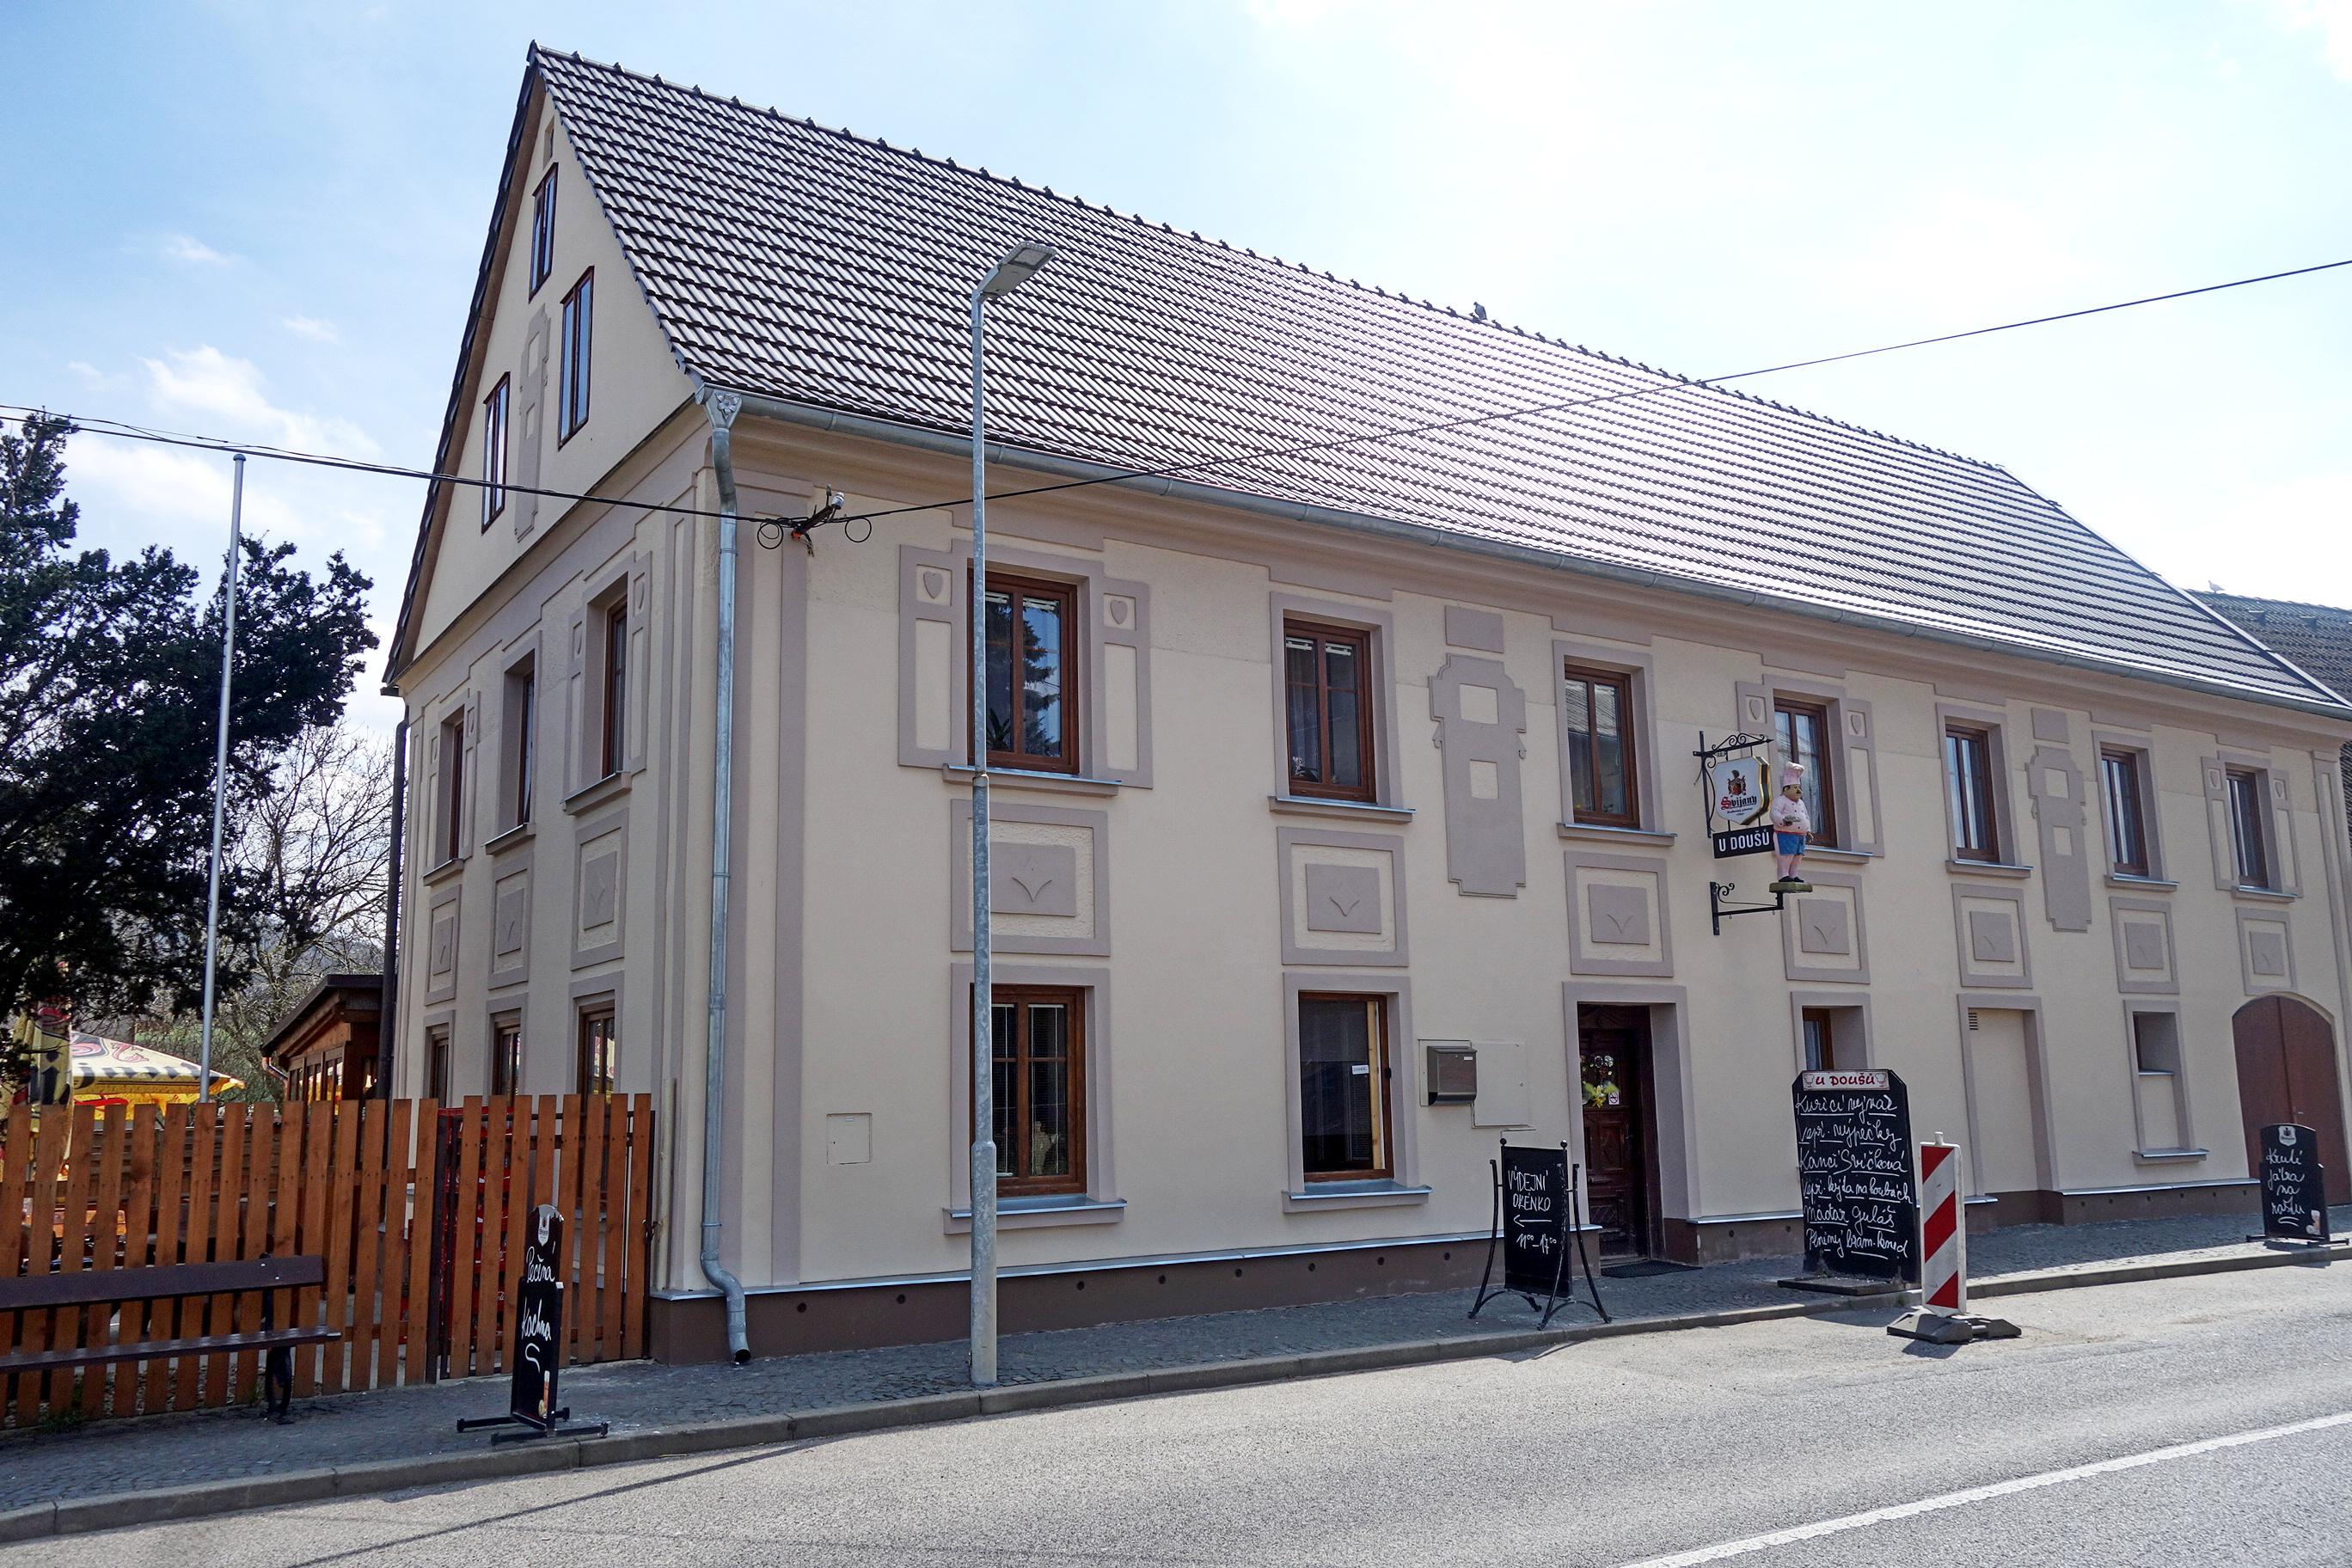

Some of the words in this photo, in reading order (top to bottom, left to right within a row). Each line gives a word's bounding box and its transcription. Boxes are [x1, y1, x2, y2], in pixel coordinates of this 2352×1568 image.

[1721, 795, 1757, 810] Svijany
[1719, 838, 1726, 852] U
[1730, 829, 1770, 850] DOUŠŮ
[1829, 1072, 1875, 1087] DOUŠŮ
[1508, 1166, 1548, 1191] VÝDEJNÍ
[1513, 1192, 1551, 1211] OKÉNKO
